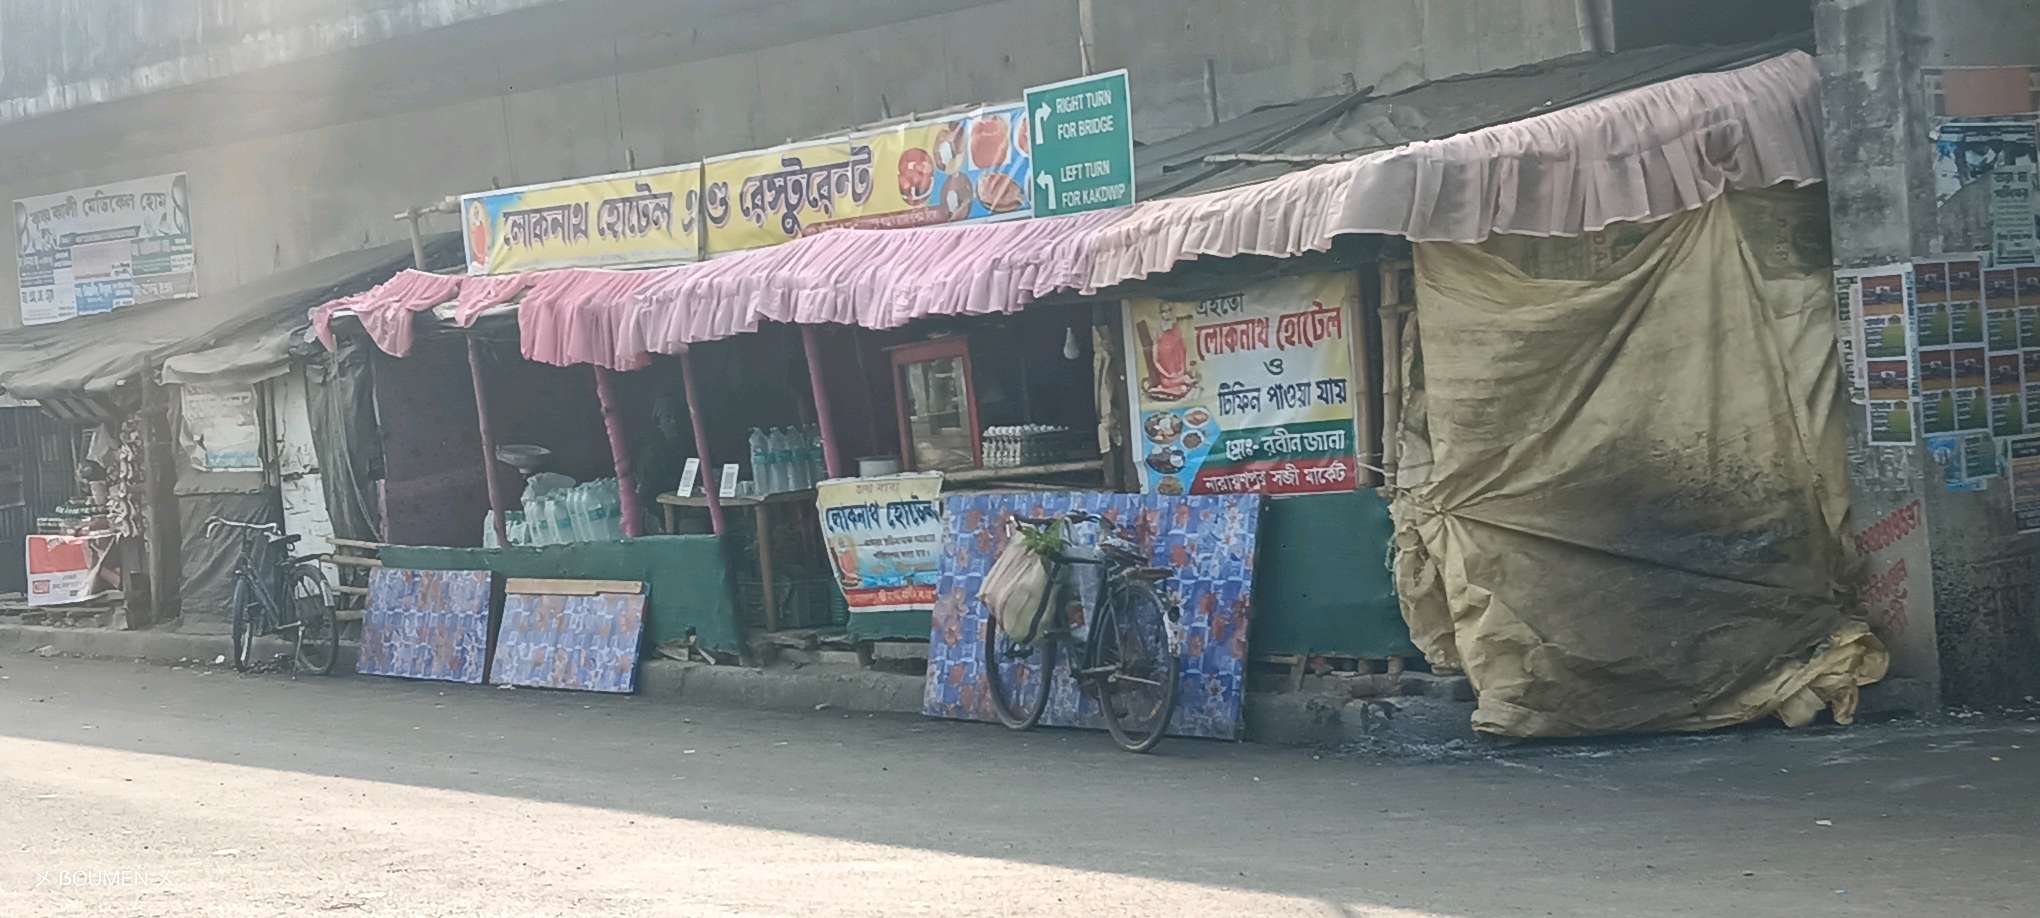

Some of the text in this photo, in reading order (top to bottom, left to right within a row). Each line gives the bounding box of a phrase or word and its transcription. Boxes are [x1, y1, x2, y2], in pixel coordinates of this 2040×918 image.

[1056, 90, 1111, 113] RIGHT TURN
[1057, 115, 1114, 139] FOR BRIDGE
[1061, 160, 1110, 182] LEFT TURN
[1062, 184, 1125, 207] FOR KAKDWIP
[504, 201, 591, 248] লোকনাথ
[597, 183, 674, 240] হোটেল
[1196, 301, 1342, 361] লোকনাথ হোটেল
[1264, 358, 1284, 375] ও
[1217, 378, 1347, 416] টিফিন পাওয়া যায়
[1302, 430, 1345, 451] জানা
[825, 501, 880, 533] লোকনাথ
